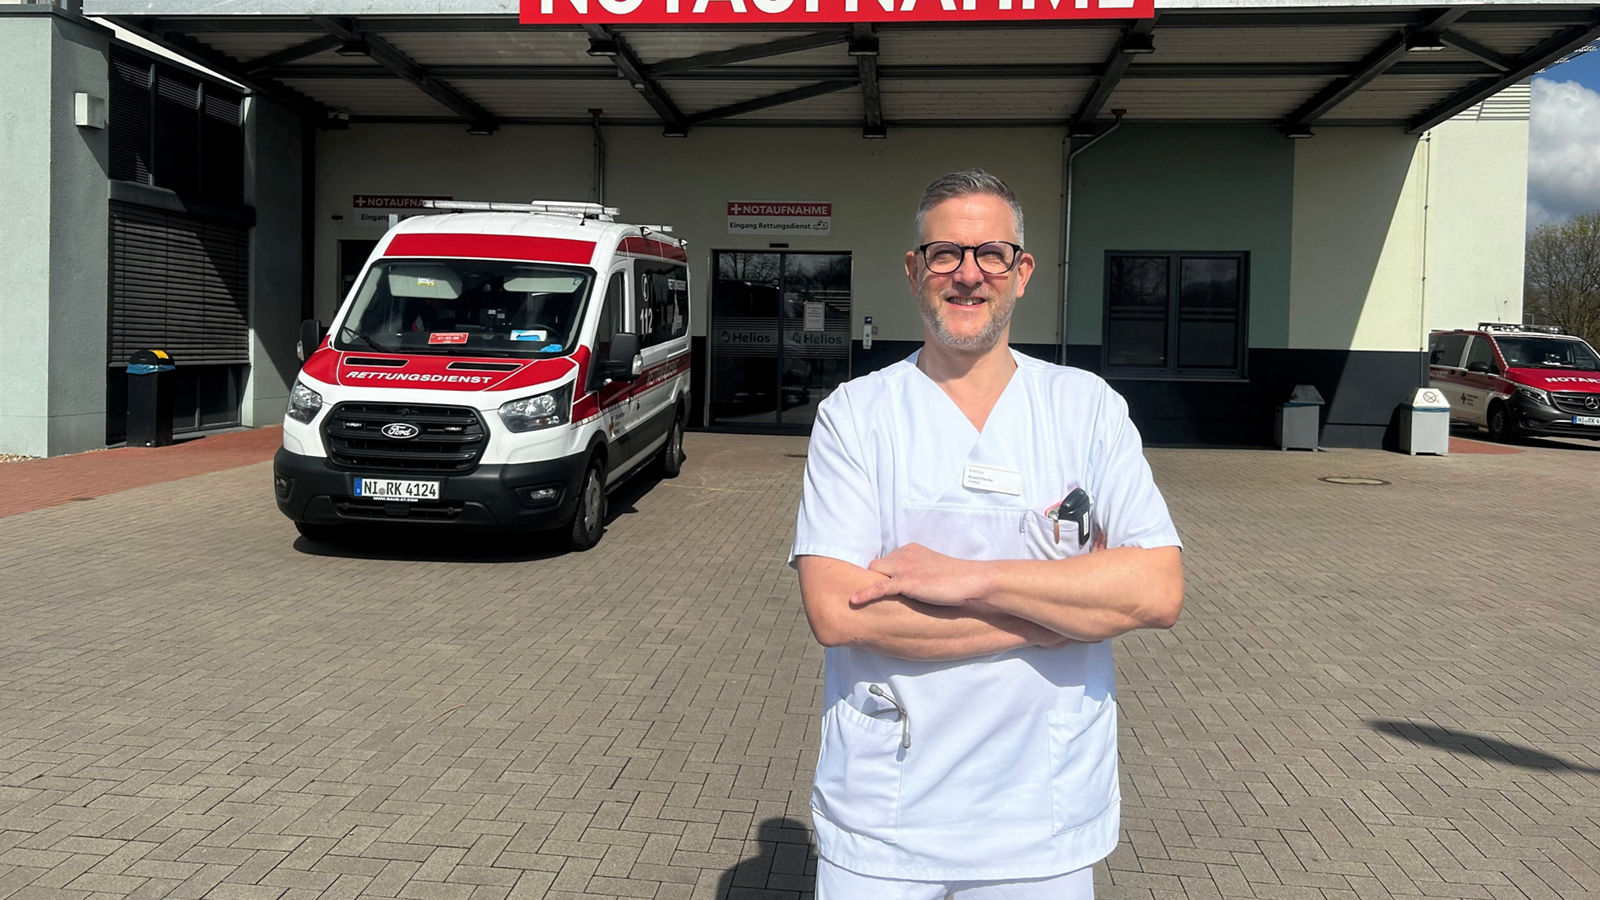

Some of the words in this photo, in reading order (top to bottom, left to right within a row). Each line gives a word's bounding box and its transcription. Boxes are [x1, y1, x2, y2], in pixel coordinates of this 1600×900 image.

[743, 205, 828, 215] NOTAUFNAHME
[729, 222, 757, 230] Eingang
[759, 222, 811, 231] Rettungsdienst
[640, 307, 653, 335] 112
[732, 331, 771, 343] Helios
[803, 333, 842, 344] Helios
[345, 371, 493, 384] RETTUNGSDIENST
[387, 425, 412, 437] Ford
[364, 480, 378, 494] NI
[386, 482, 402, 496] RK
[405, 483, 437, 497] 4124
